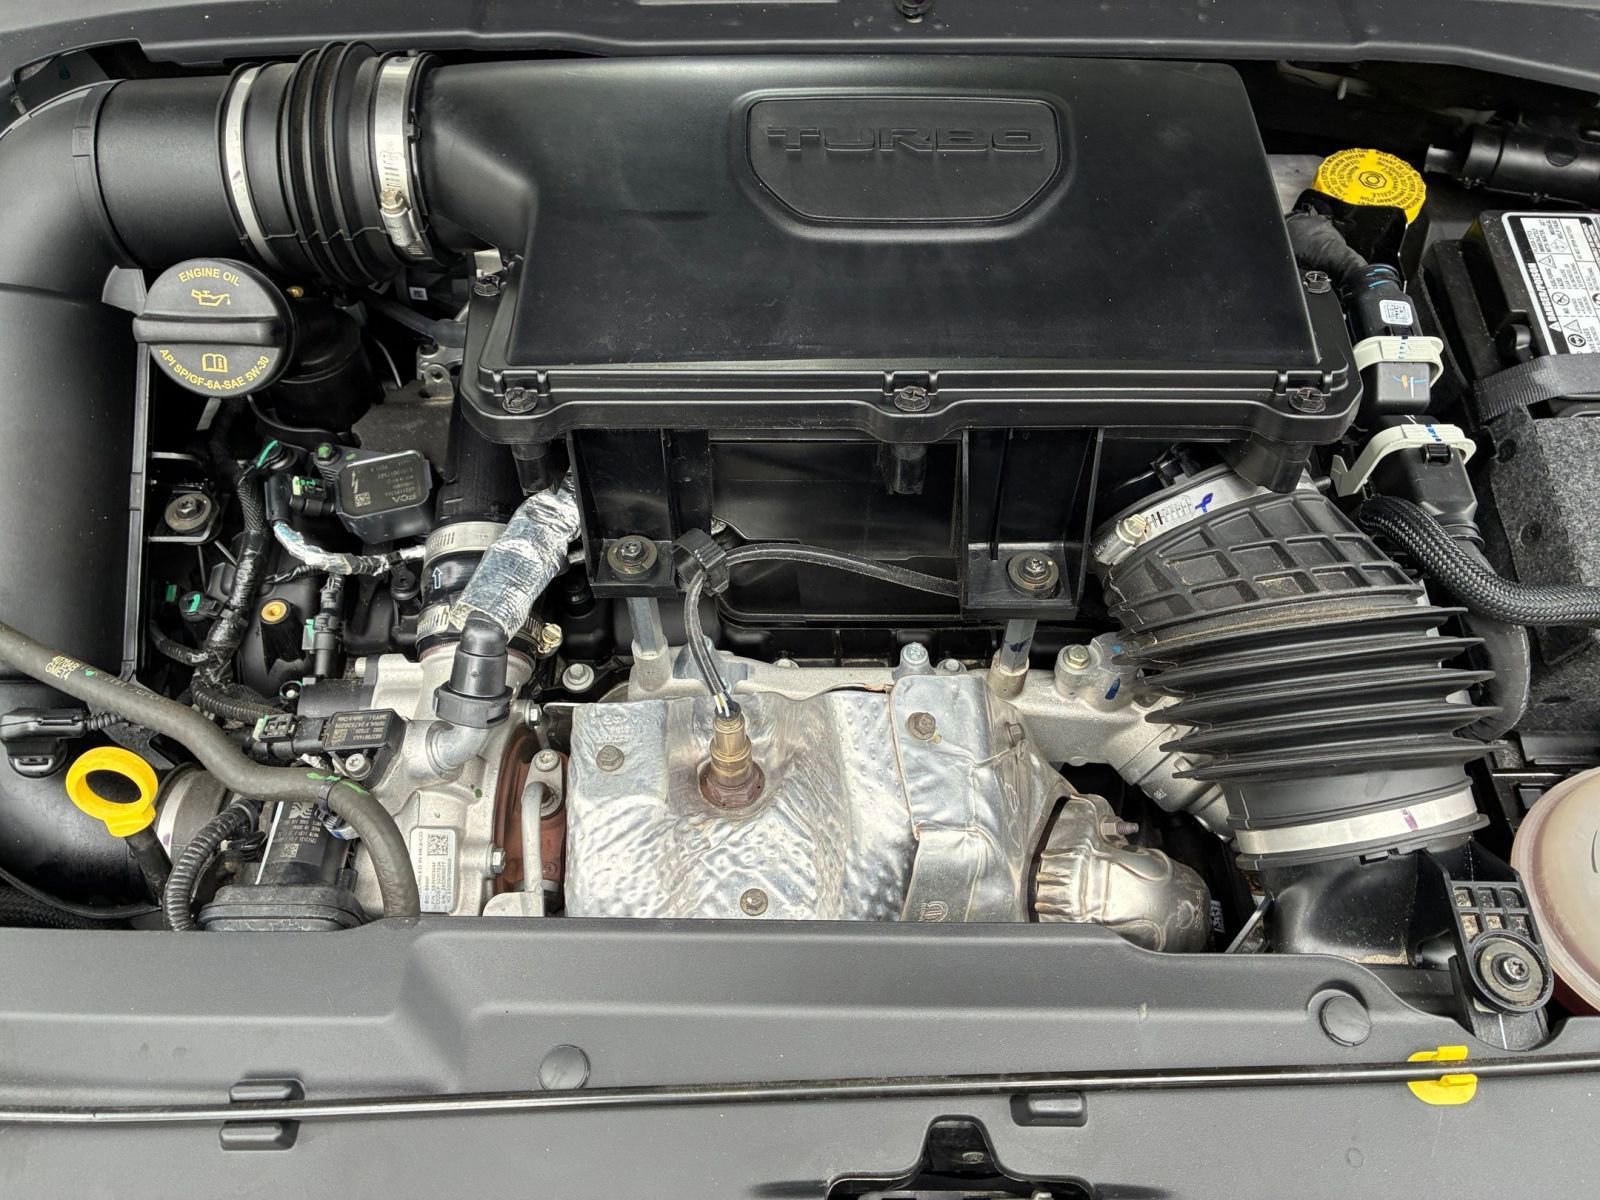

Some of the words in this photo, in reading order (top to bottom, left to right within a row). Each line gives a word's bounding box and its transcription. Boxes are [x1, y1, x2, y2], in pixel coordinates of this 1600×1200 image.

[768, 125, 1045, 153] TURBO
[178, 267, 220, 283] ENGINE
[223, 272, 240, 286] OIL
[1527, 263, 1558, 322] DANGER/POISON
[159, 349, 176, 367] API
[174, 364, 246, 390] SP/GF-6A-SAE
[245, 355, 269, 381] 5W-30
[392, 493, 416, 503] FCA
